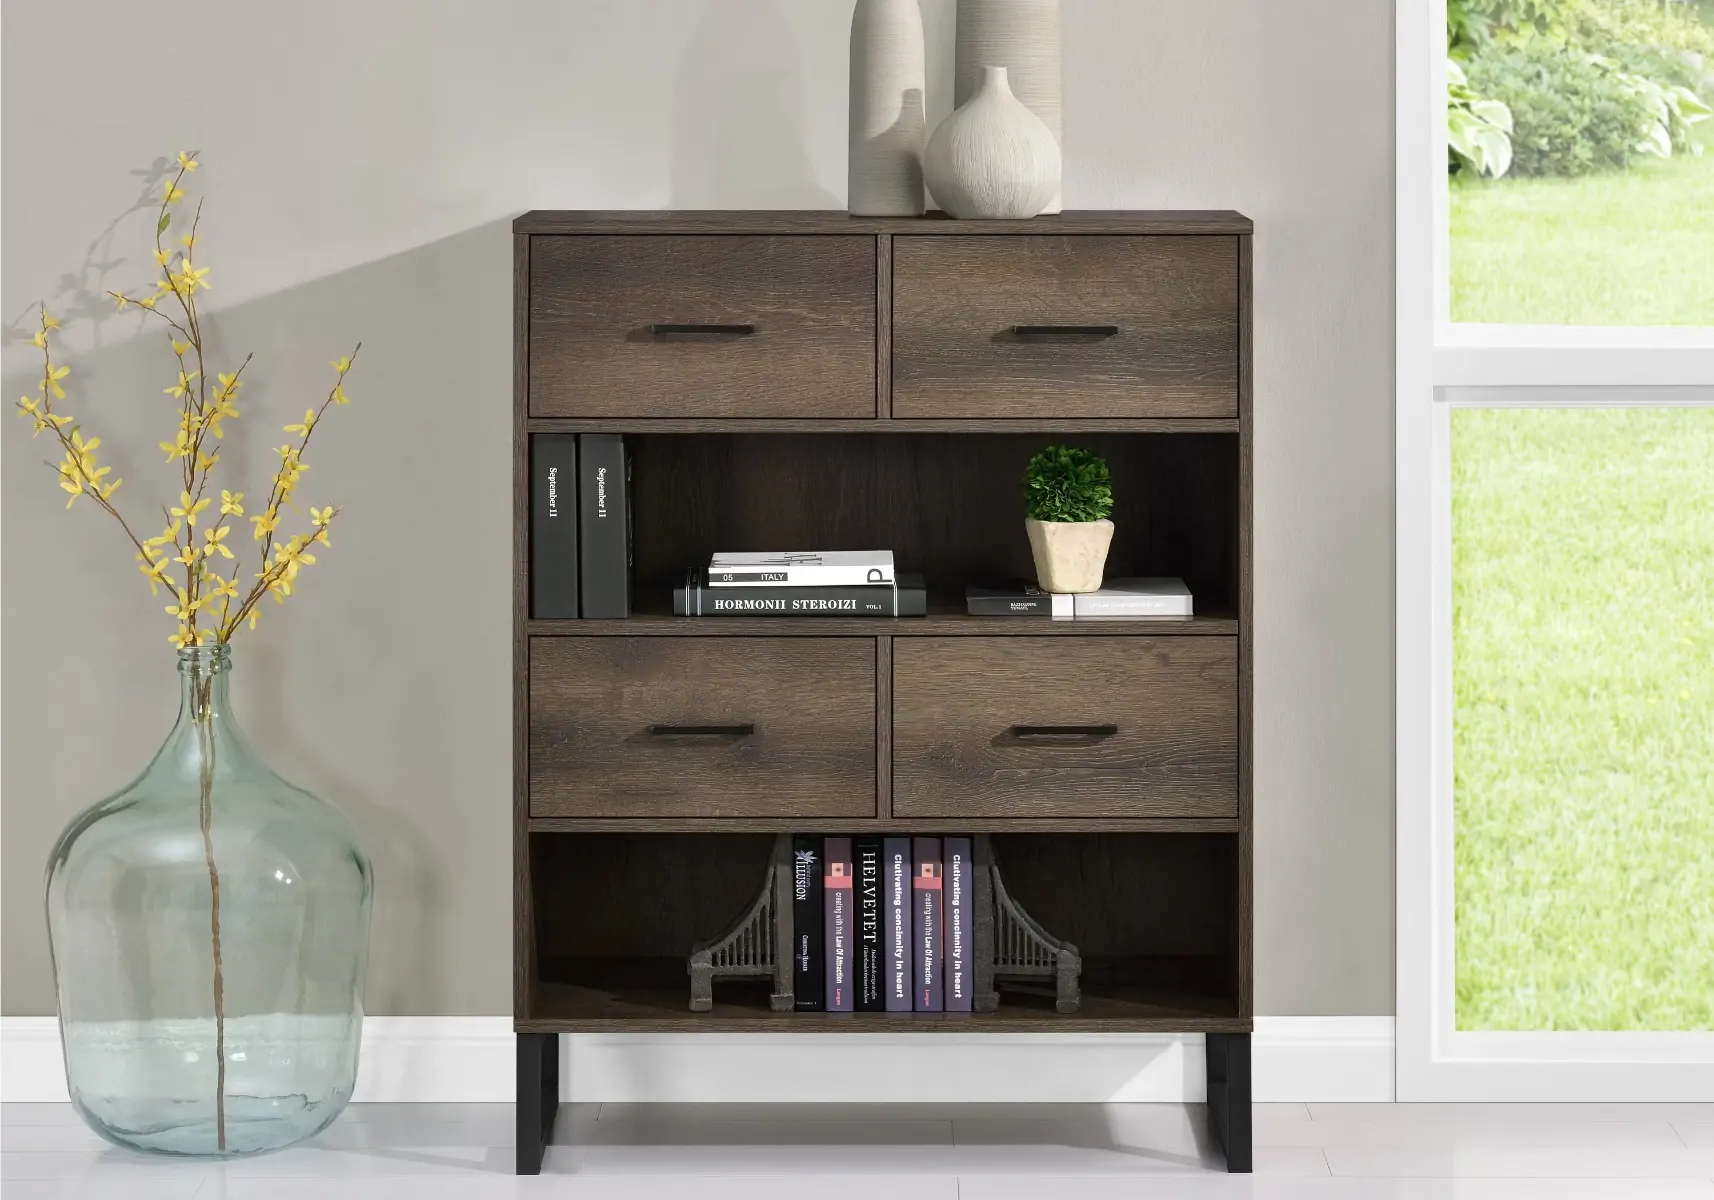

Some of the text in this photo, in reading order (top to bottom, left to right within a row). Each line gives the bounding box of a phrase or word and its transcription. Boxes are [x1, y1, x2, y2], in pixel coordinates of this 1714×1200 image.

[548, 467, 558, 518] September 11
[596, 467, 606, 518] September 11
[722, 573, 784, 582] 05 ITALY
[714, 600, 786, 610] HORMONII
[792, 600, 857, 610] STEROIZI
[796, 860, 809, 900] ILLUSION
[834, 892, 843, 914] creating
[863, 852, 876, 943] HELVETET
[924, 893, 932, 914] creating
[894, 908, 903, 958] concinnity
[924, 915, 932, 926] with
[924, 927, 932, 936] the
[953, 908, 962, 958] concinnity
[836, 956, 844, 984] Attraction
[924, 957, 932, 985] Attraction
